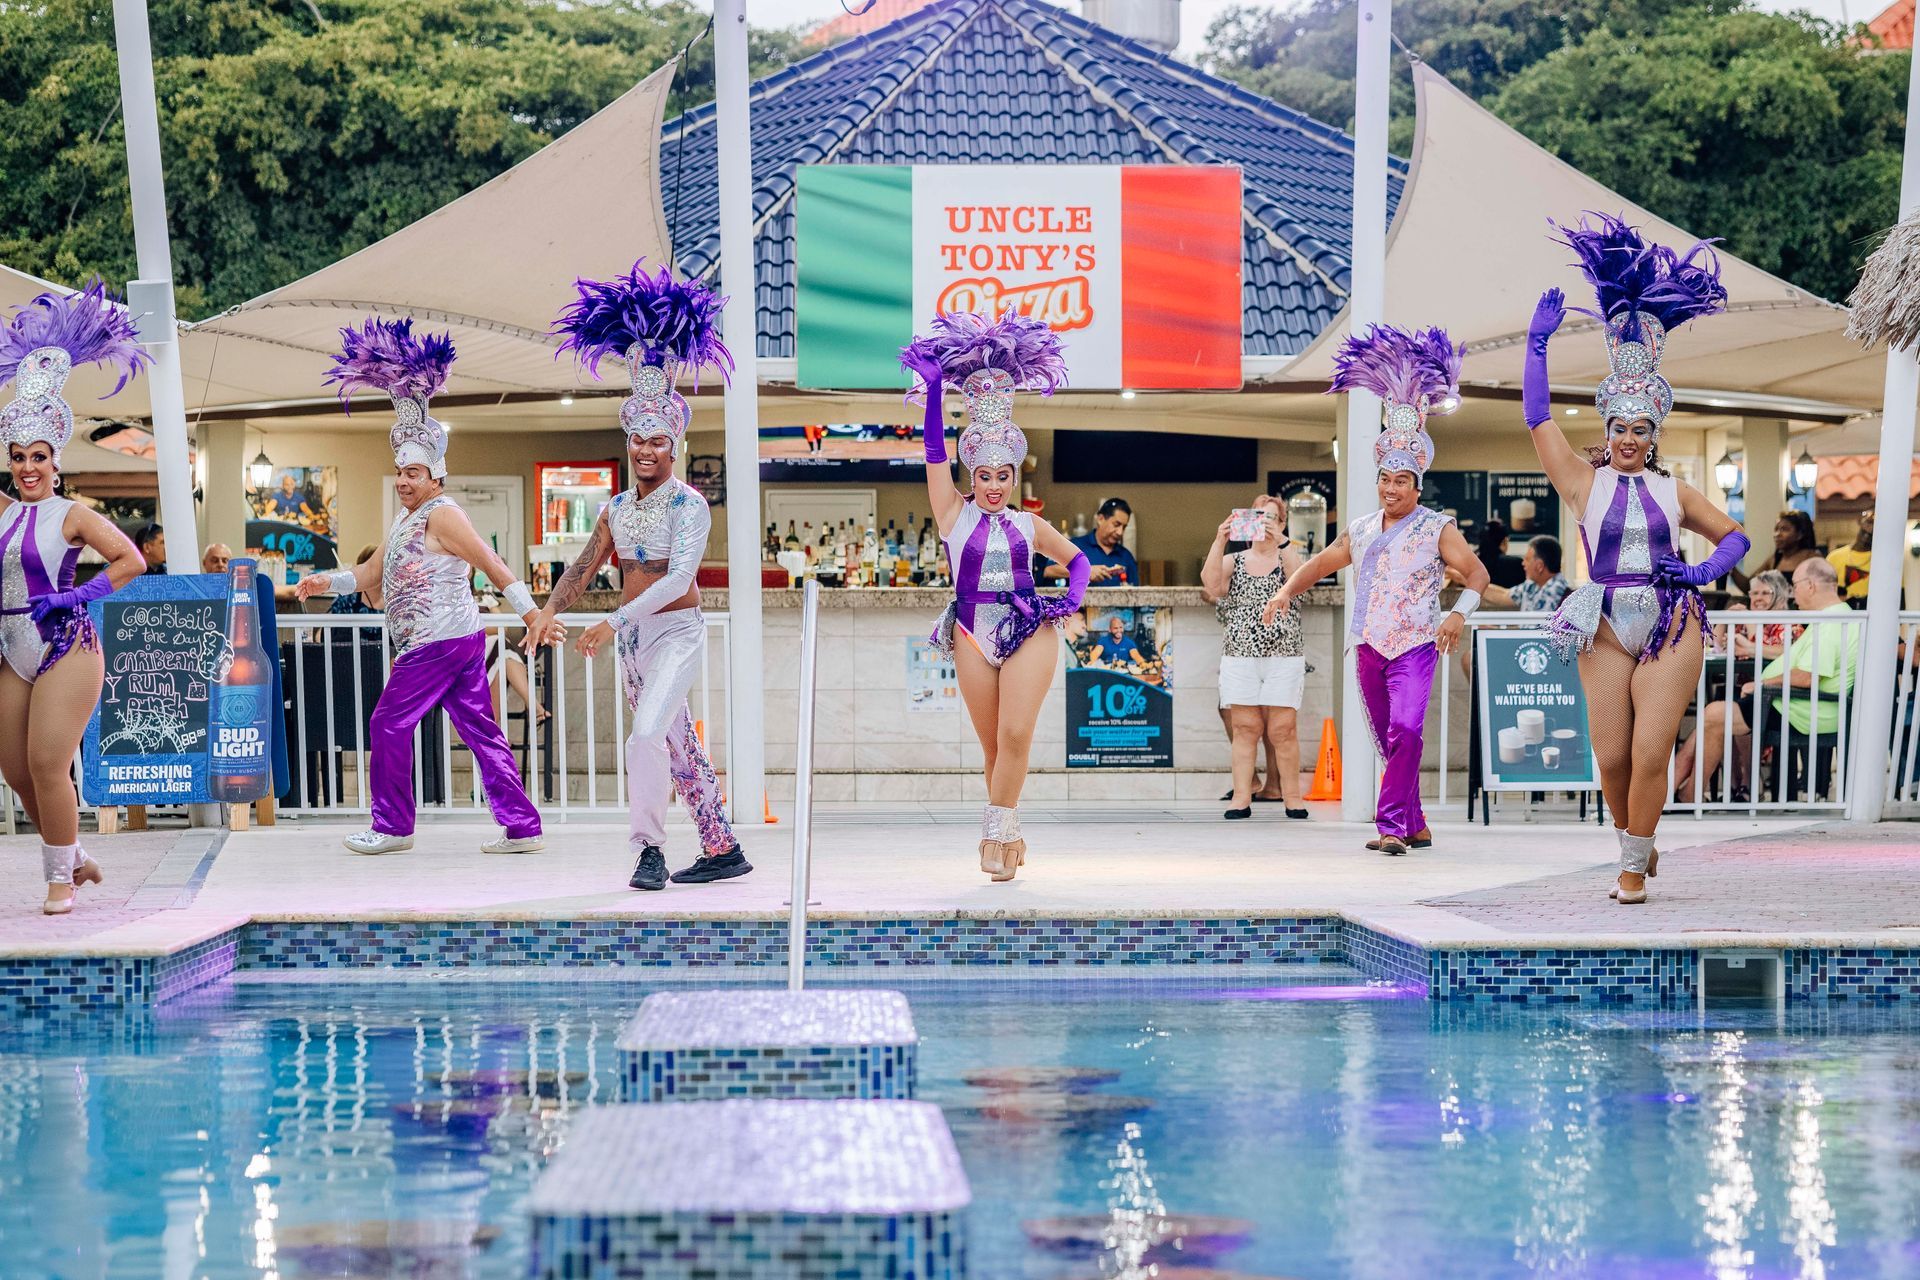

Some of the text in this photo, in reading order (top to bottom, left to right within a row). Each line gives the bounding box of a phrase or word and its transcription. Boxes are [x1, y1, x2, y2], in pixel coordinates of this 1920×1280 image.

[944, 206, 1092, 234] UNCLE
[940, 244, 1096, 272] TONY'S
[938, 277, 1092, 331] Pizza
[263, 532, 314, 563] 10%
[142, 627, 167, 644] the
[1506, 683, 1562, 694] WE'VE BEAN
[1087, 683, 1147, 718] 10%
[1494, 695, 1575, 706] WAITING FOR YOU
[218, 727, 259, 743] BUD
[213, 741, 265, 758] LIGHT
[108, 765, 193, 781] REFRESHING
[108, 781, 192, 794] AMERICAN LAGER
